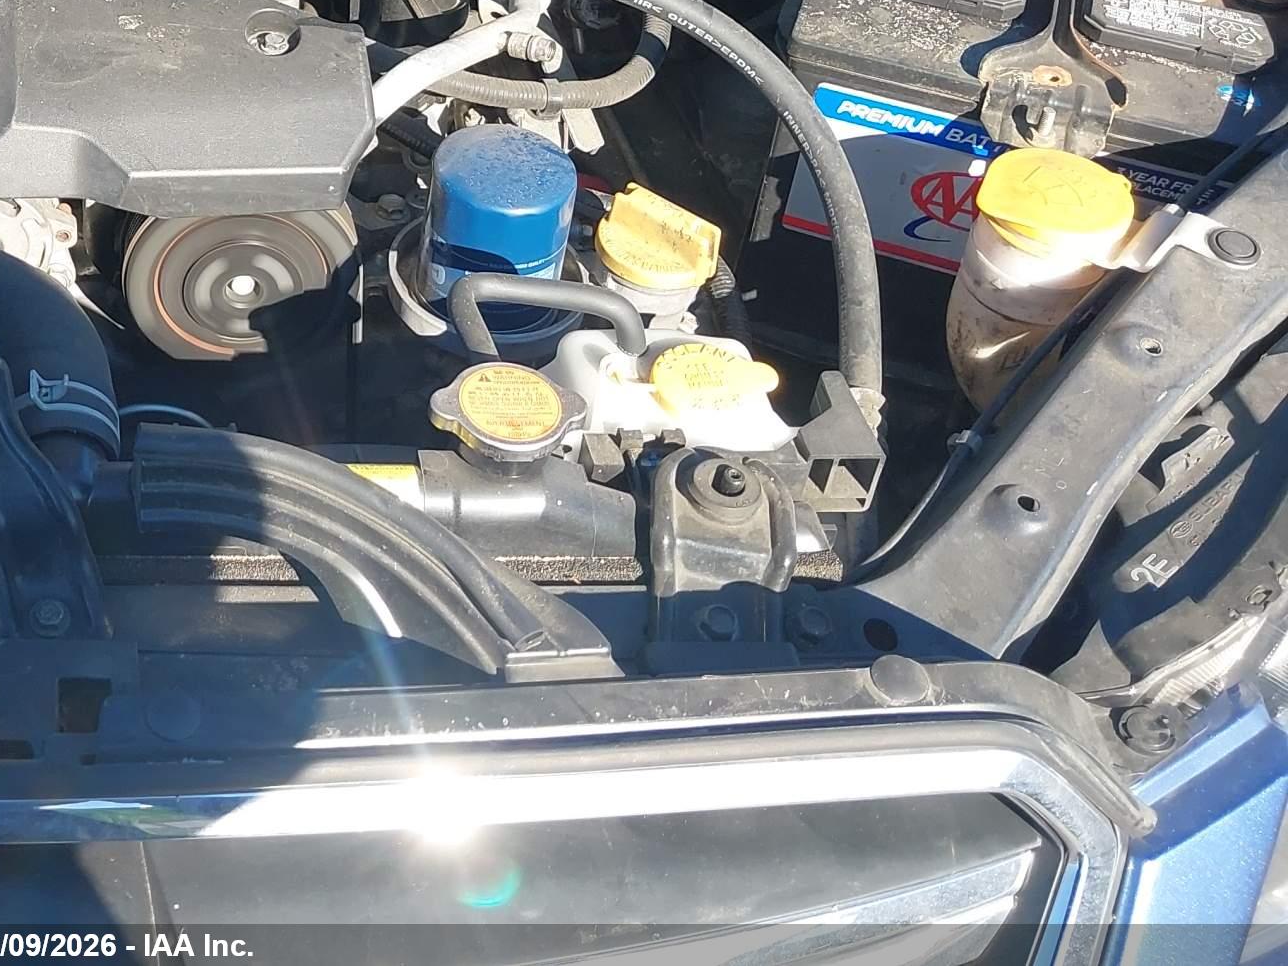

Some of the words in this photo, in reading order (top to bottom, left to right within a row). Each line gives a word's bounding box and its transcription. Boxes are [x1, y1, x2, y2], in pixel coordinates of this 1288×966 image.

[667, 12, 765, 86] OUTER>EPDM<
[837, 100, 946, 138] PREMIUM
[1128, 170, 1171, 189] YEAR
[1170, 180, 1215, 202] FRE
[1130, 553, 1179, 589] 2E
